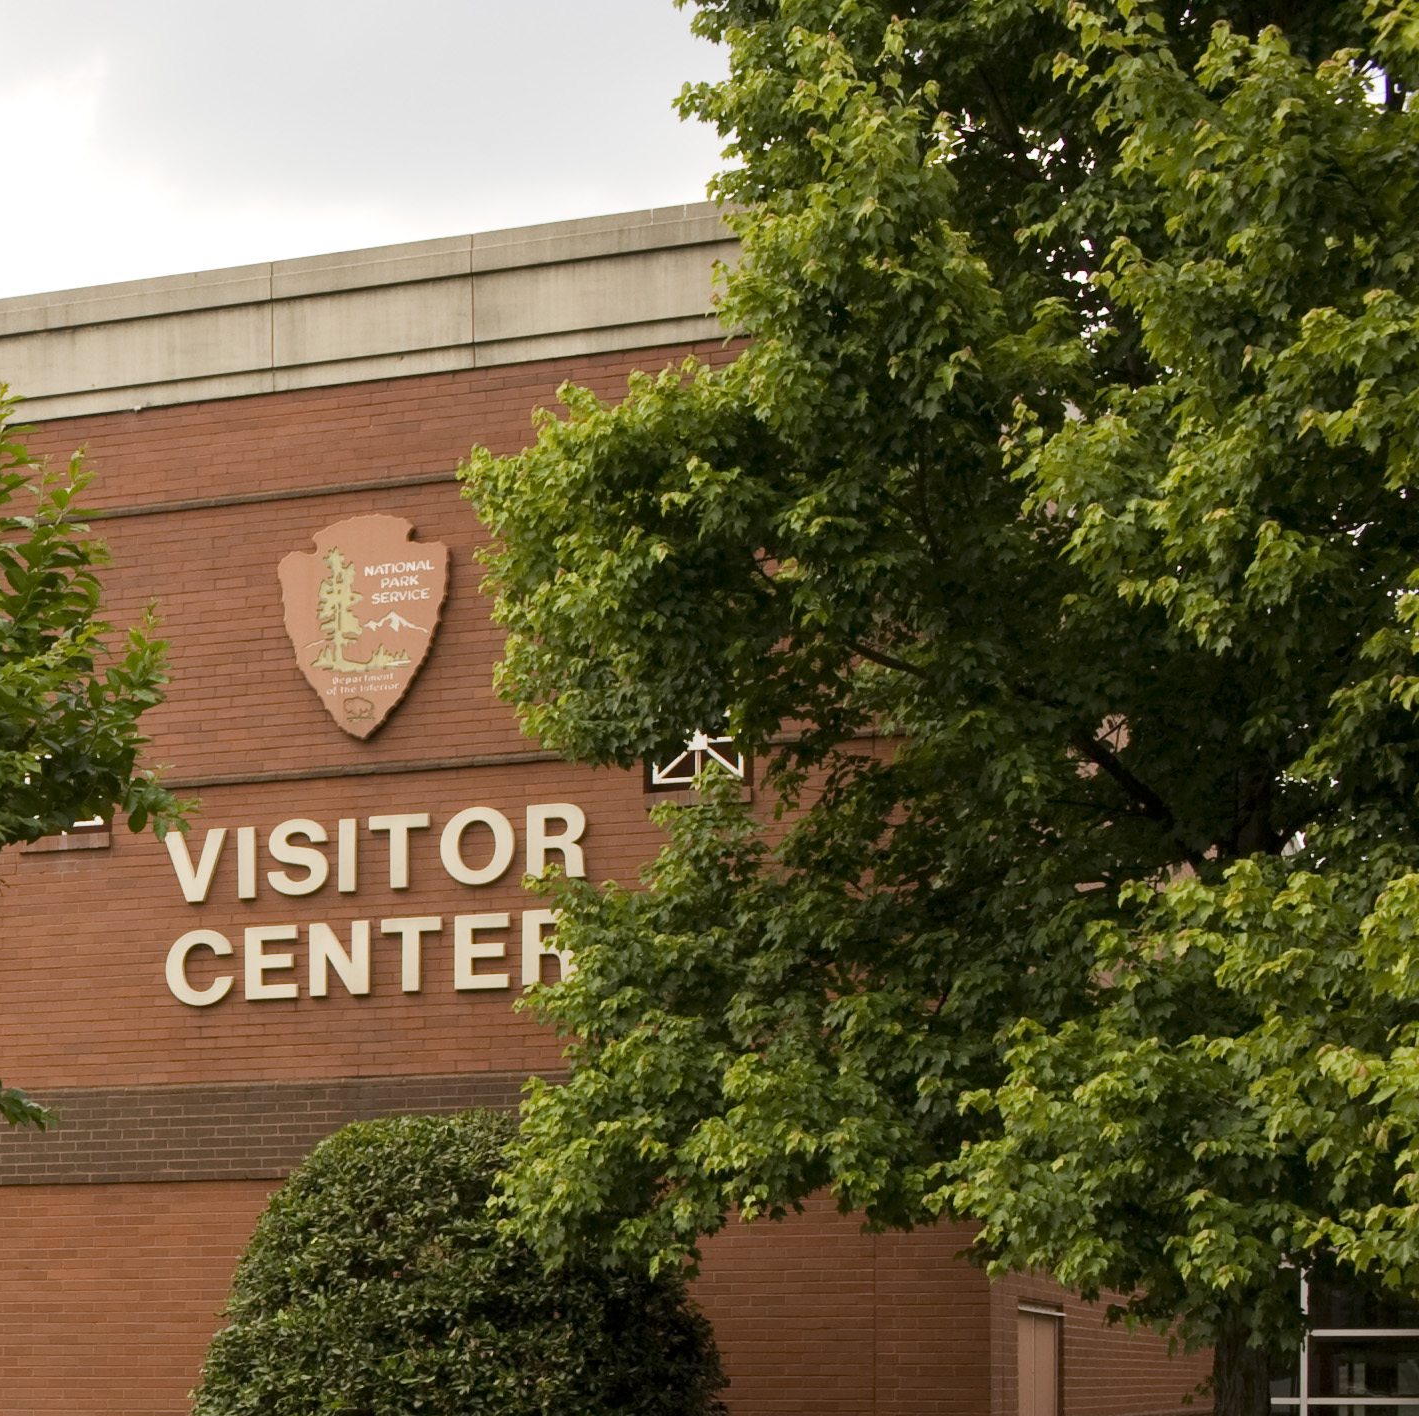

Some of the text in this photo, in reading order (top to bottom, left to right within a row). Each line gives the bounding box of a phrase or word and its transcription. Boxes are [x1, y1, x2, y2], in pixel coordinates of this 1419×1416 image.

[363, 559, 435, 577] NATIONAL
[380, 575, 420, 589] PARK
[370, 587, 431, 605] SERVICE
[331, 672, 394, 686] Department
[325, 685, 337, 696] of
[340, 684, 357, 695] the
[164, 802, 587, 903] VISITOR
[164, 908, 579, 1007] CENTER
